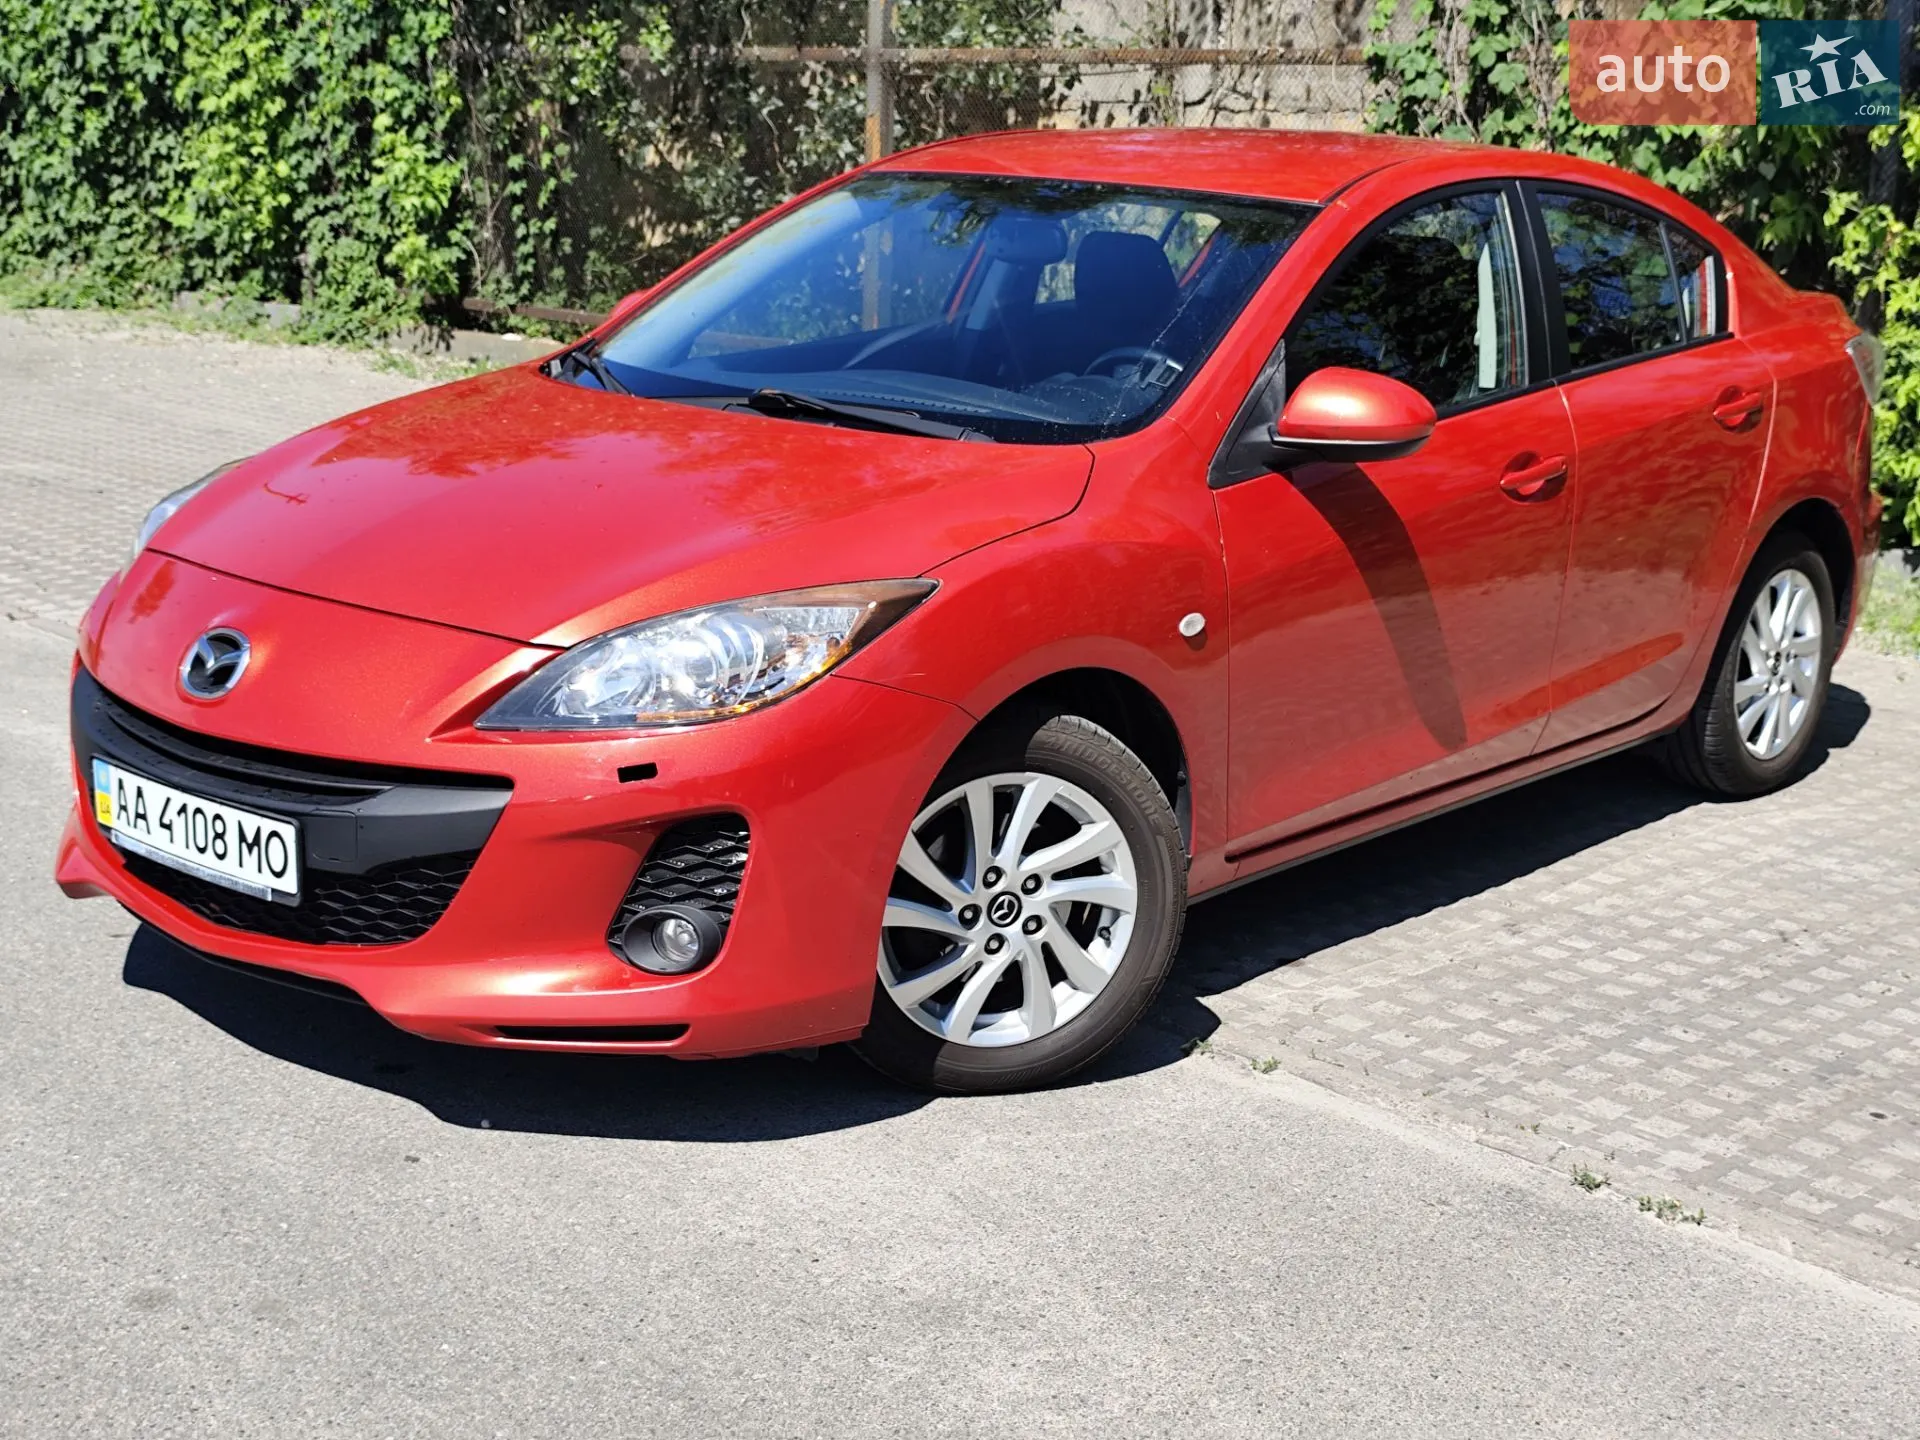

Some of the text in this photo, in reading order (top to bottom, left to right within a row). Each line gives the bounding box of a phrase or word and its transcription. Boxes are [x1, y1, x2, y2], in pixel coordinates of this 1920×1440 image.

[117, 777, 151, 835] AA
[159, 796, 228, 861] 4108
[238, 819, 289, 879] MO
